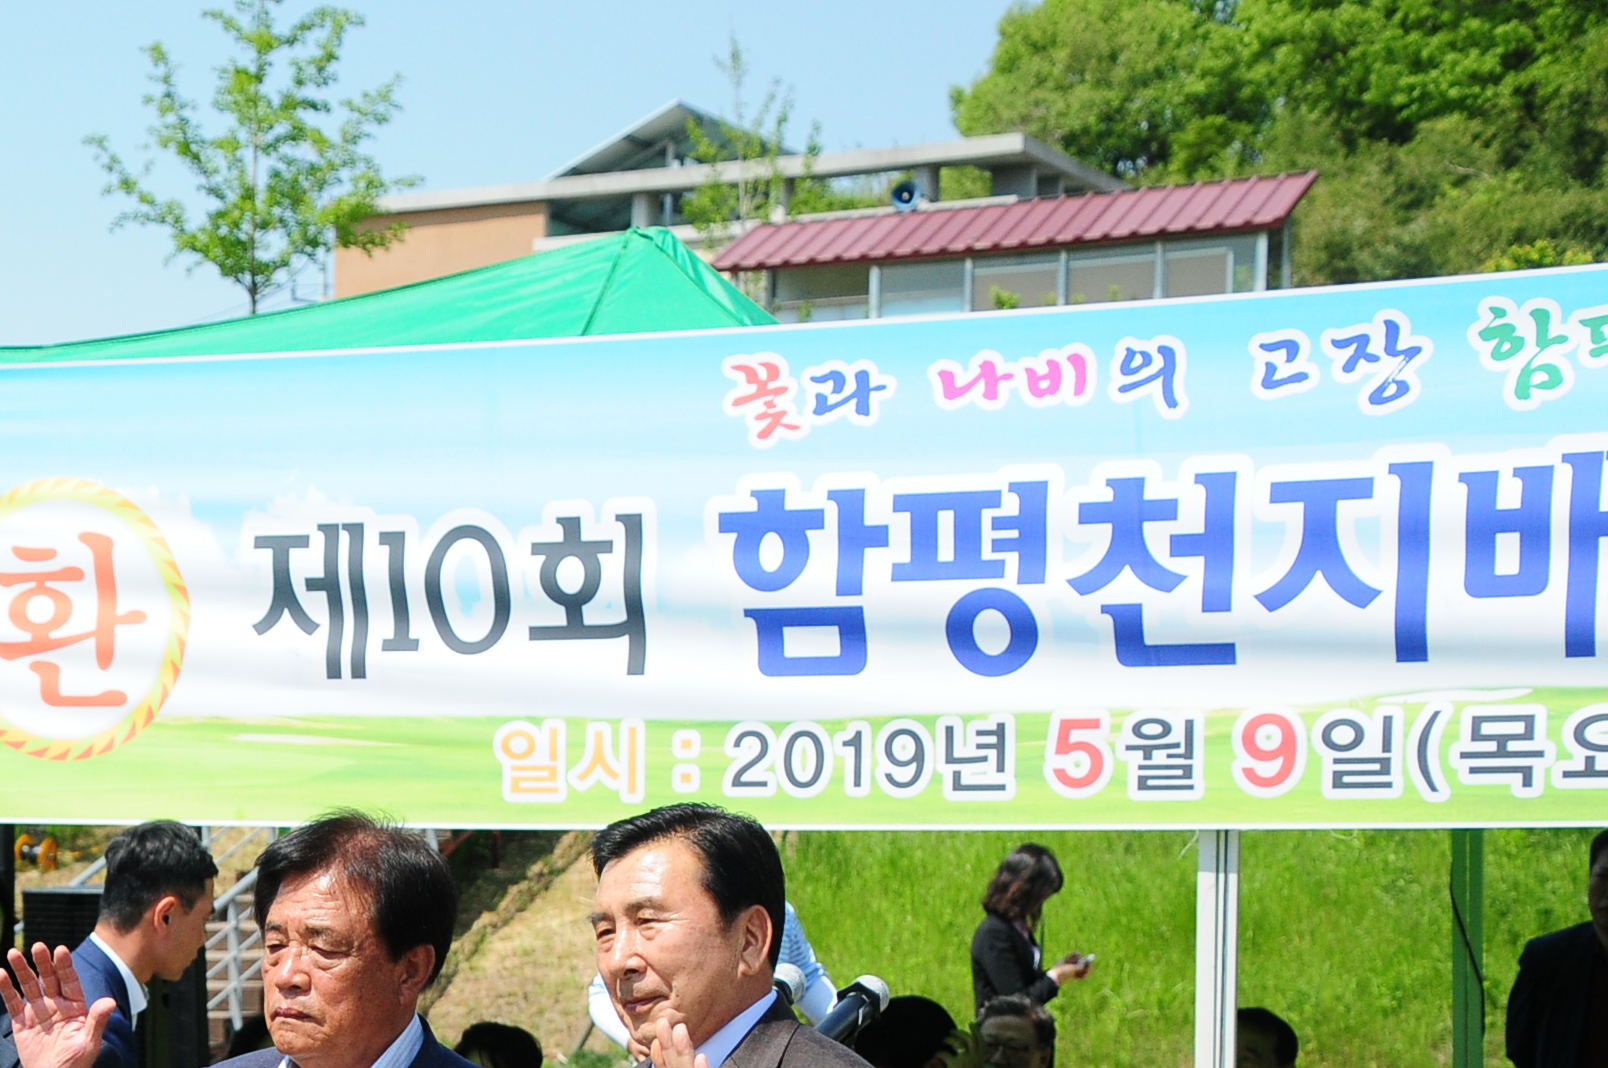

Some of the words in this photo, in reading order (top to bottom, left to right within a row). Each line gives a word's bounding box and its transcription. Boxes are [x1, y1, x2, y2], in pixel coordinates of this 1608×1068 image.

[730, 361, 888, 440] 꽃과
[937, 345, 1180, 410] 나비의
[1257, 319, 1423, 406] 고장
[252, 513, 647, 680] 제10회
[501, 724, 640, 796] 일시
[731, 722, 1007, 792] 2019년
[1052, 715, 1195, 792] 5월
